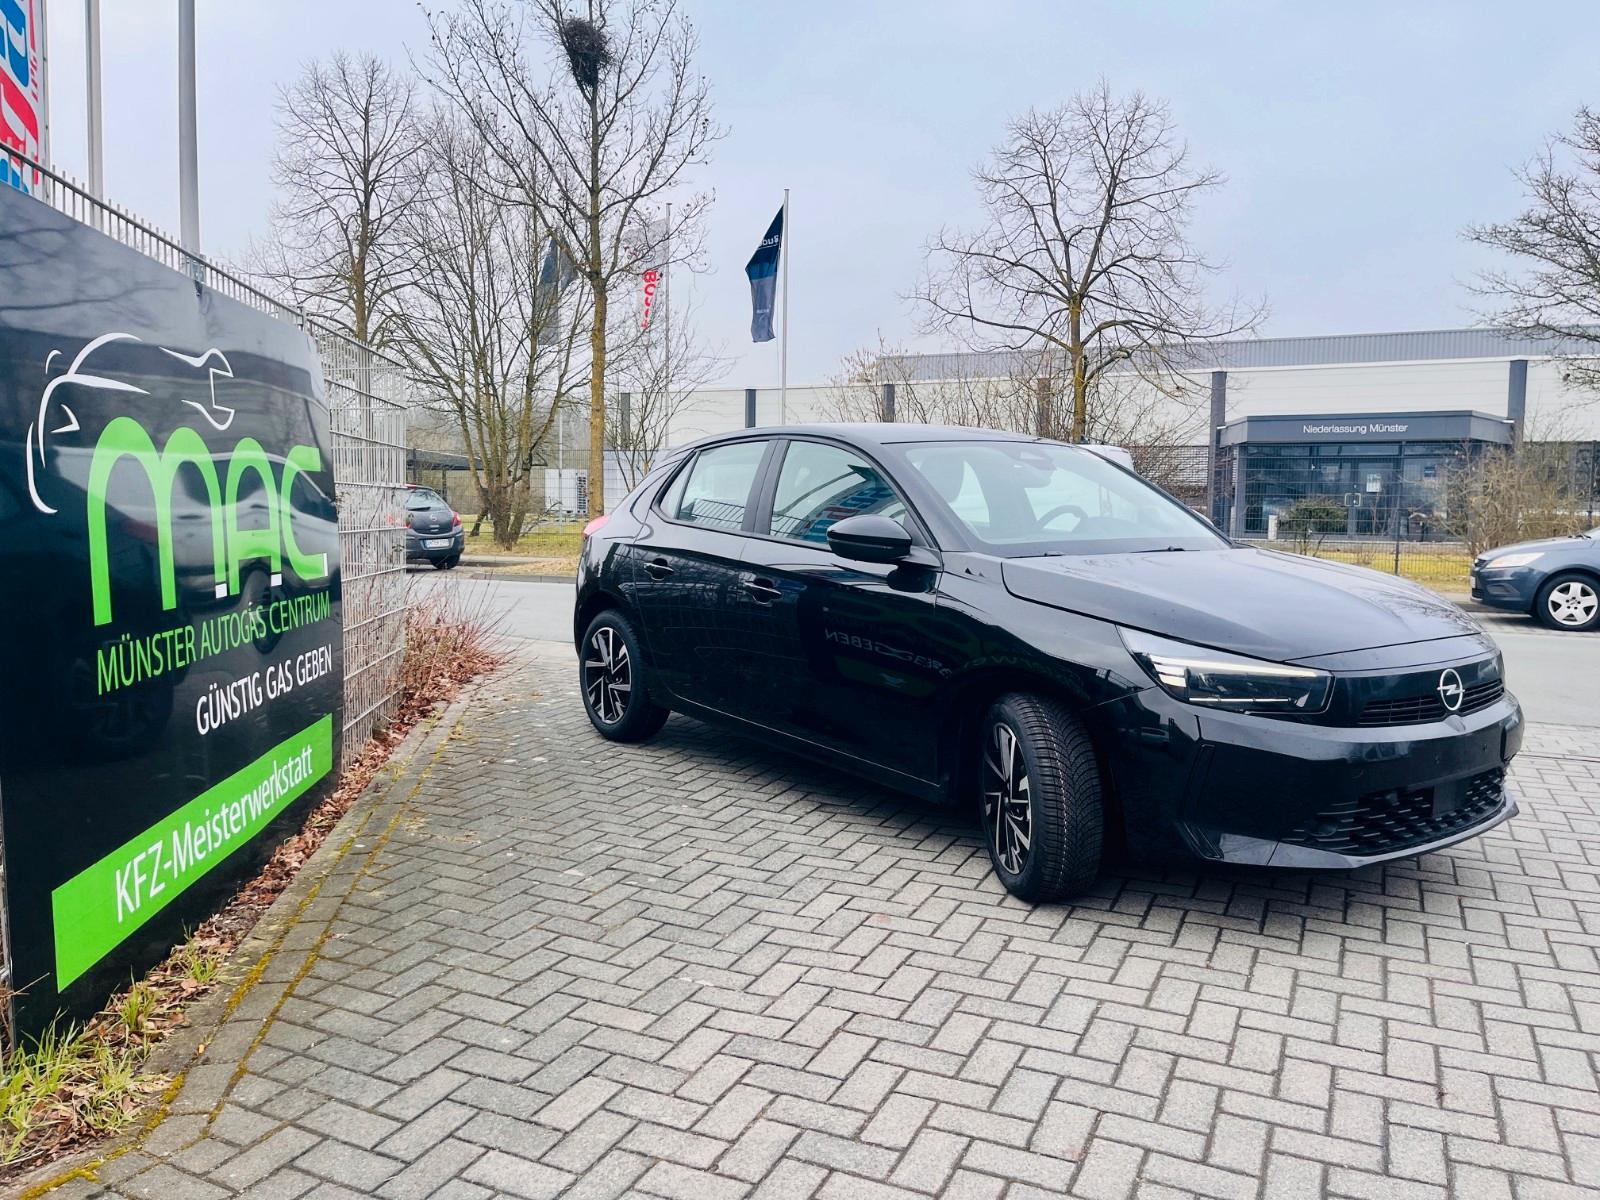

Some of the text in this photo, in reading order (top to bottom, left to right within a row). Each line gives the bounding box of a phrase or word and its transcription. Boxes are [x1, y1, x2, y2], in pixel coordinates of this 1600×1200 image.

[1303, 424, 1409, 435] Niederlassung Münster
[97, 590, 330, 695] MÜNSTER AUTOGAS CENTRUM
[196, 644, 332, 735] GÜNSTIG GAS GEBEN
[115, 743, 313, 923] KFZ-Meisterwerkstatt
